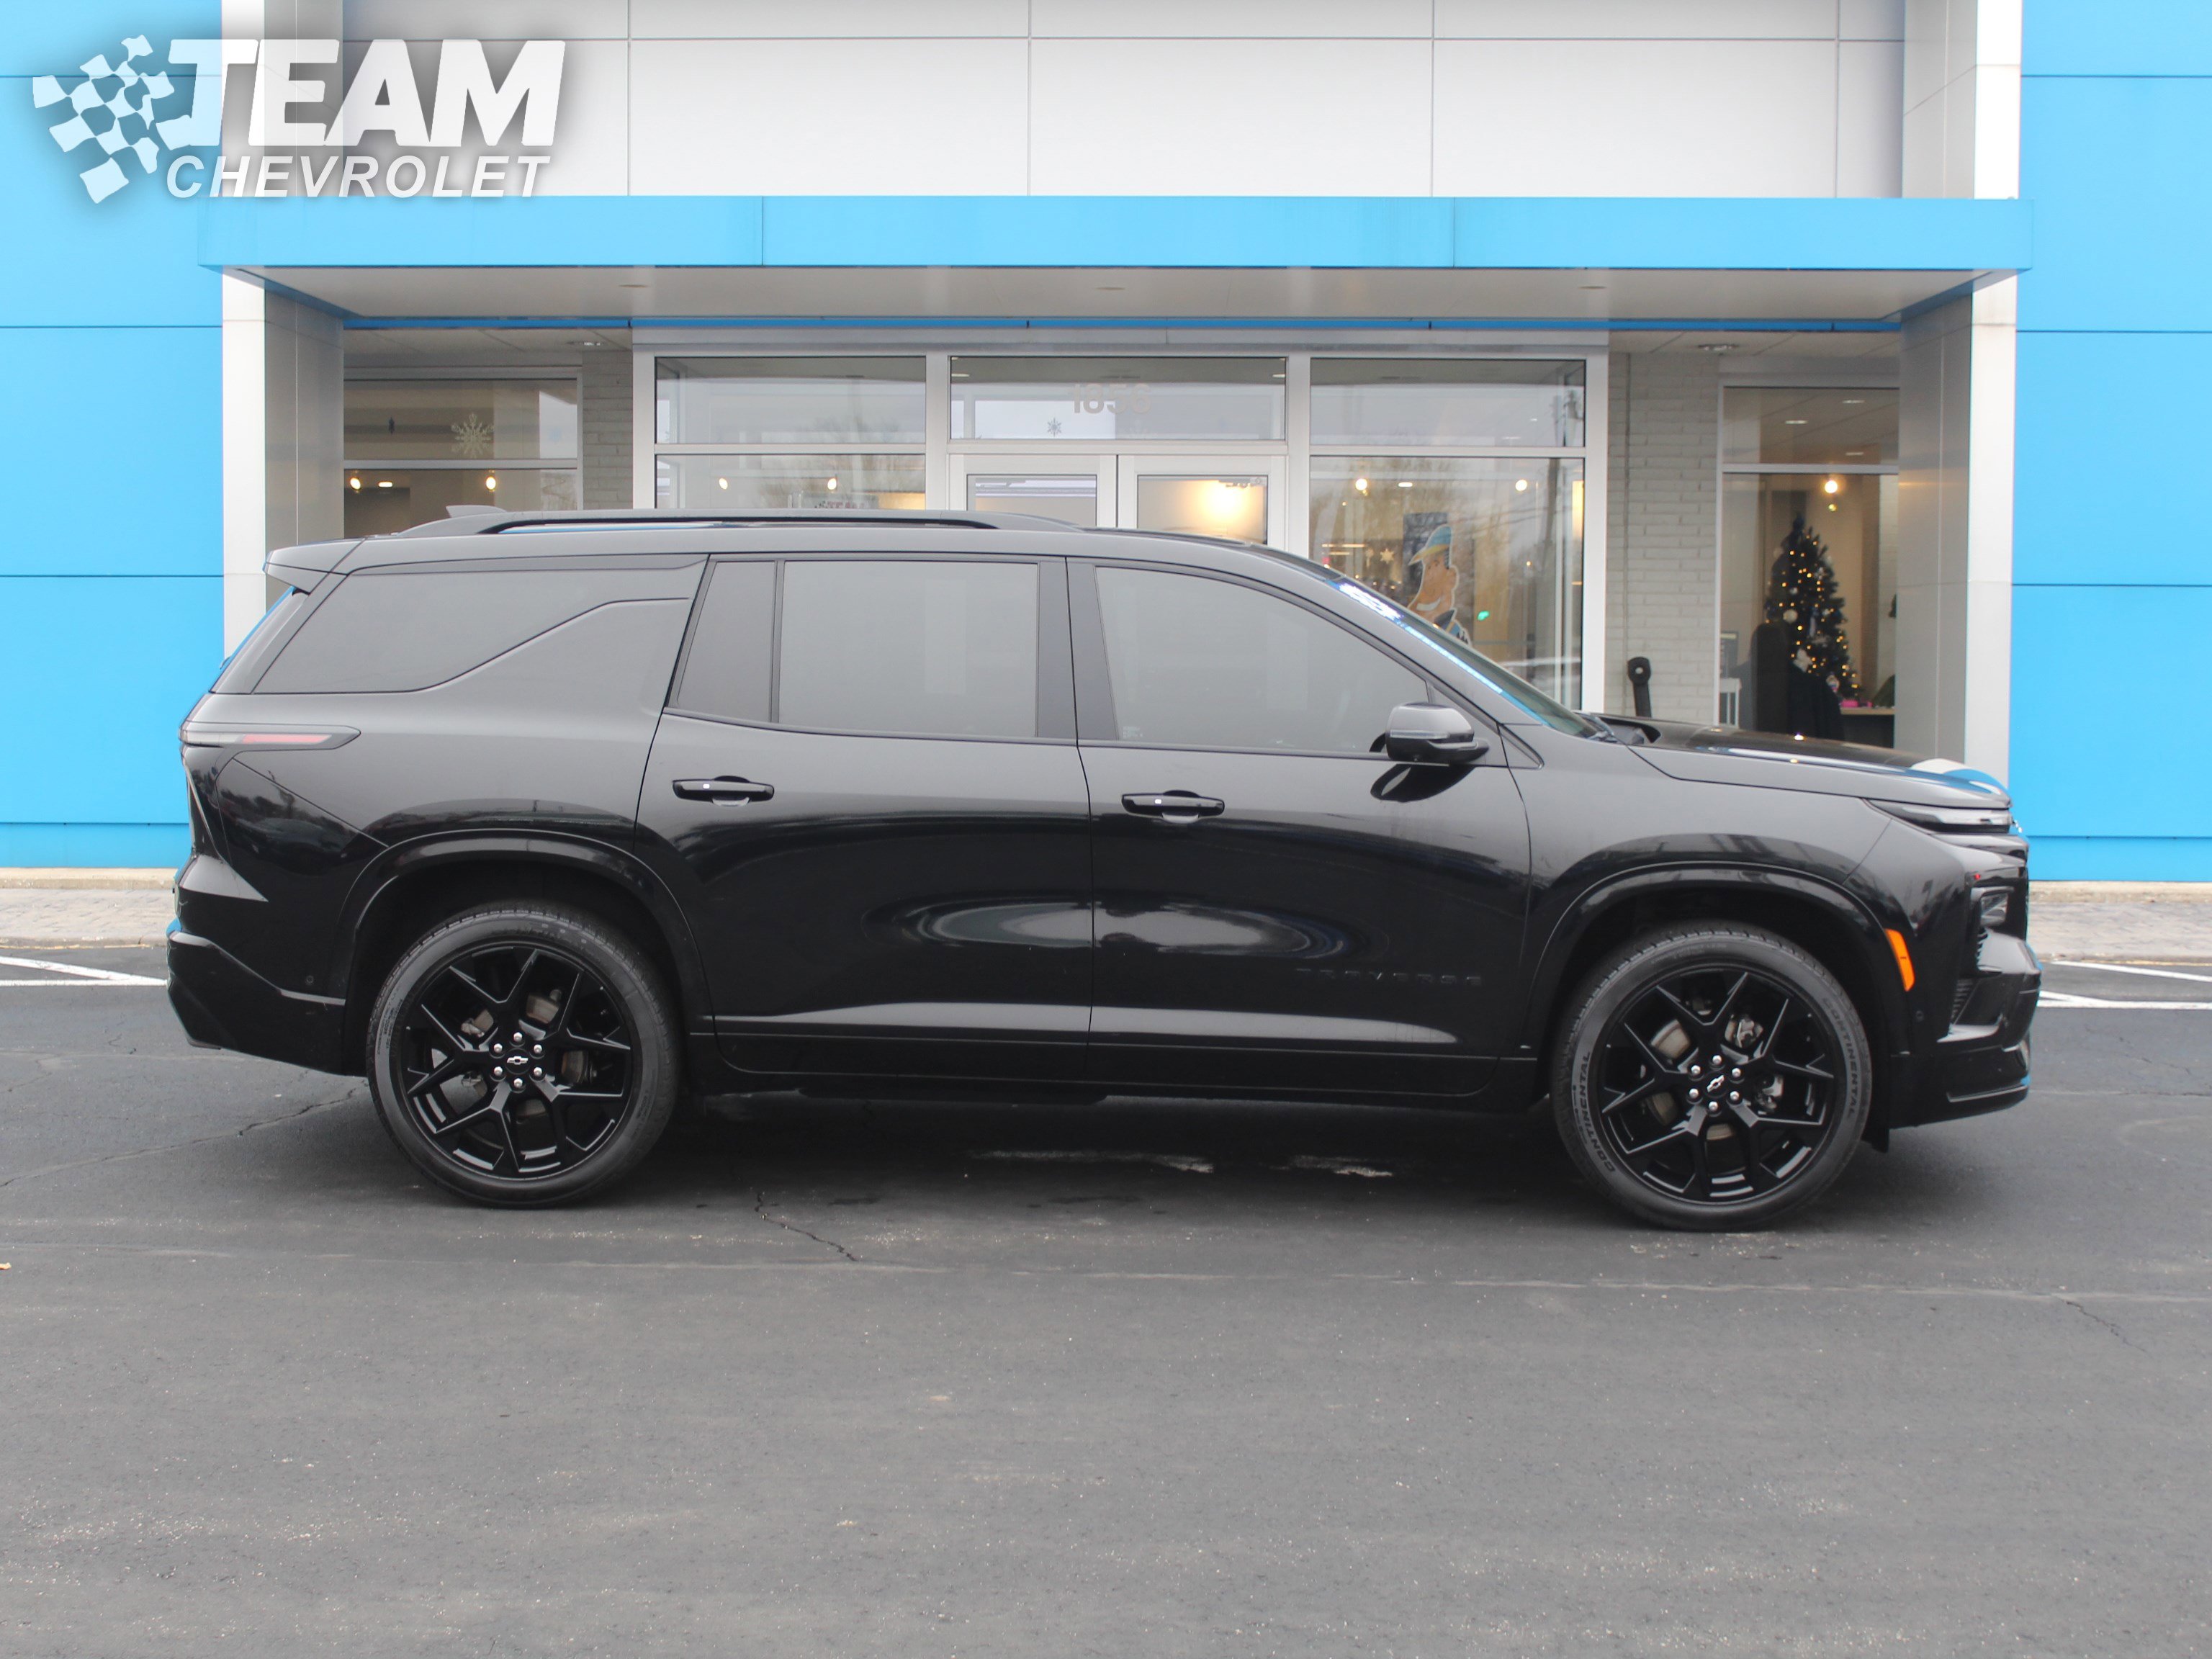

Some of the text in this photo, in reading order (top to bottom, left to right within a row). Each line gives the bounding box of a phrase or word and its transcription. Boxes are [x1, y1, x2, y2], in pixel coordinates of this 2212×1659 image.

[1073, 383, 1151, 414] 1856
[1579, 1051, 1616, 1172] CONTINENTAL
[1823, 997, 1858, 1118] CONTINENTAL
